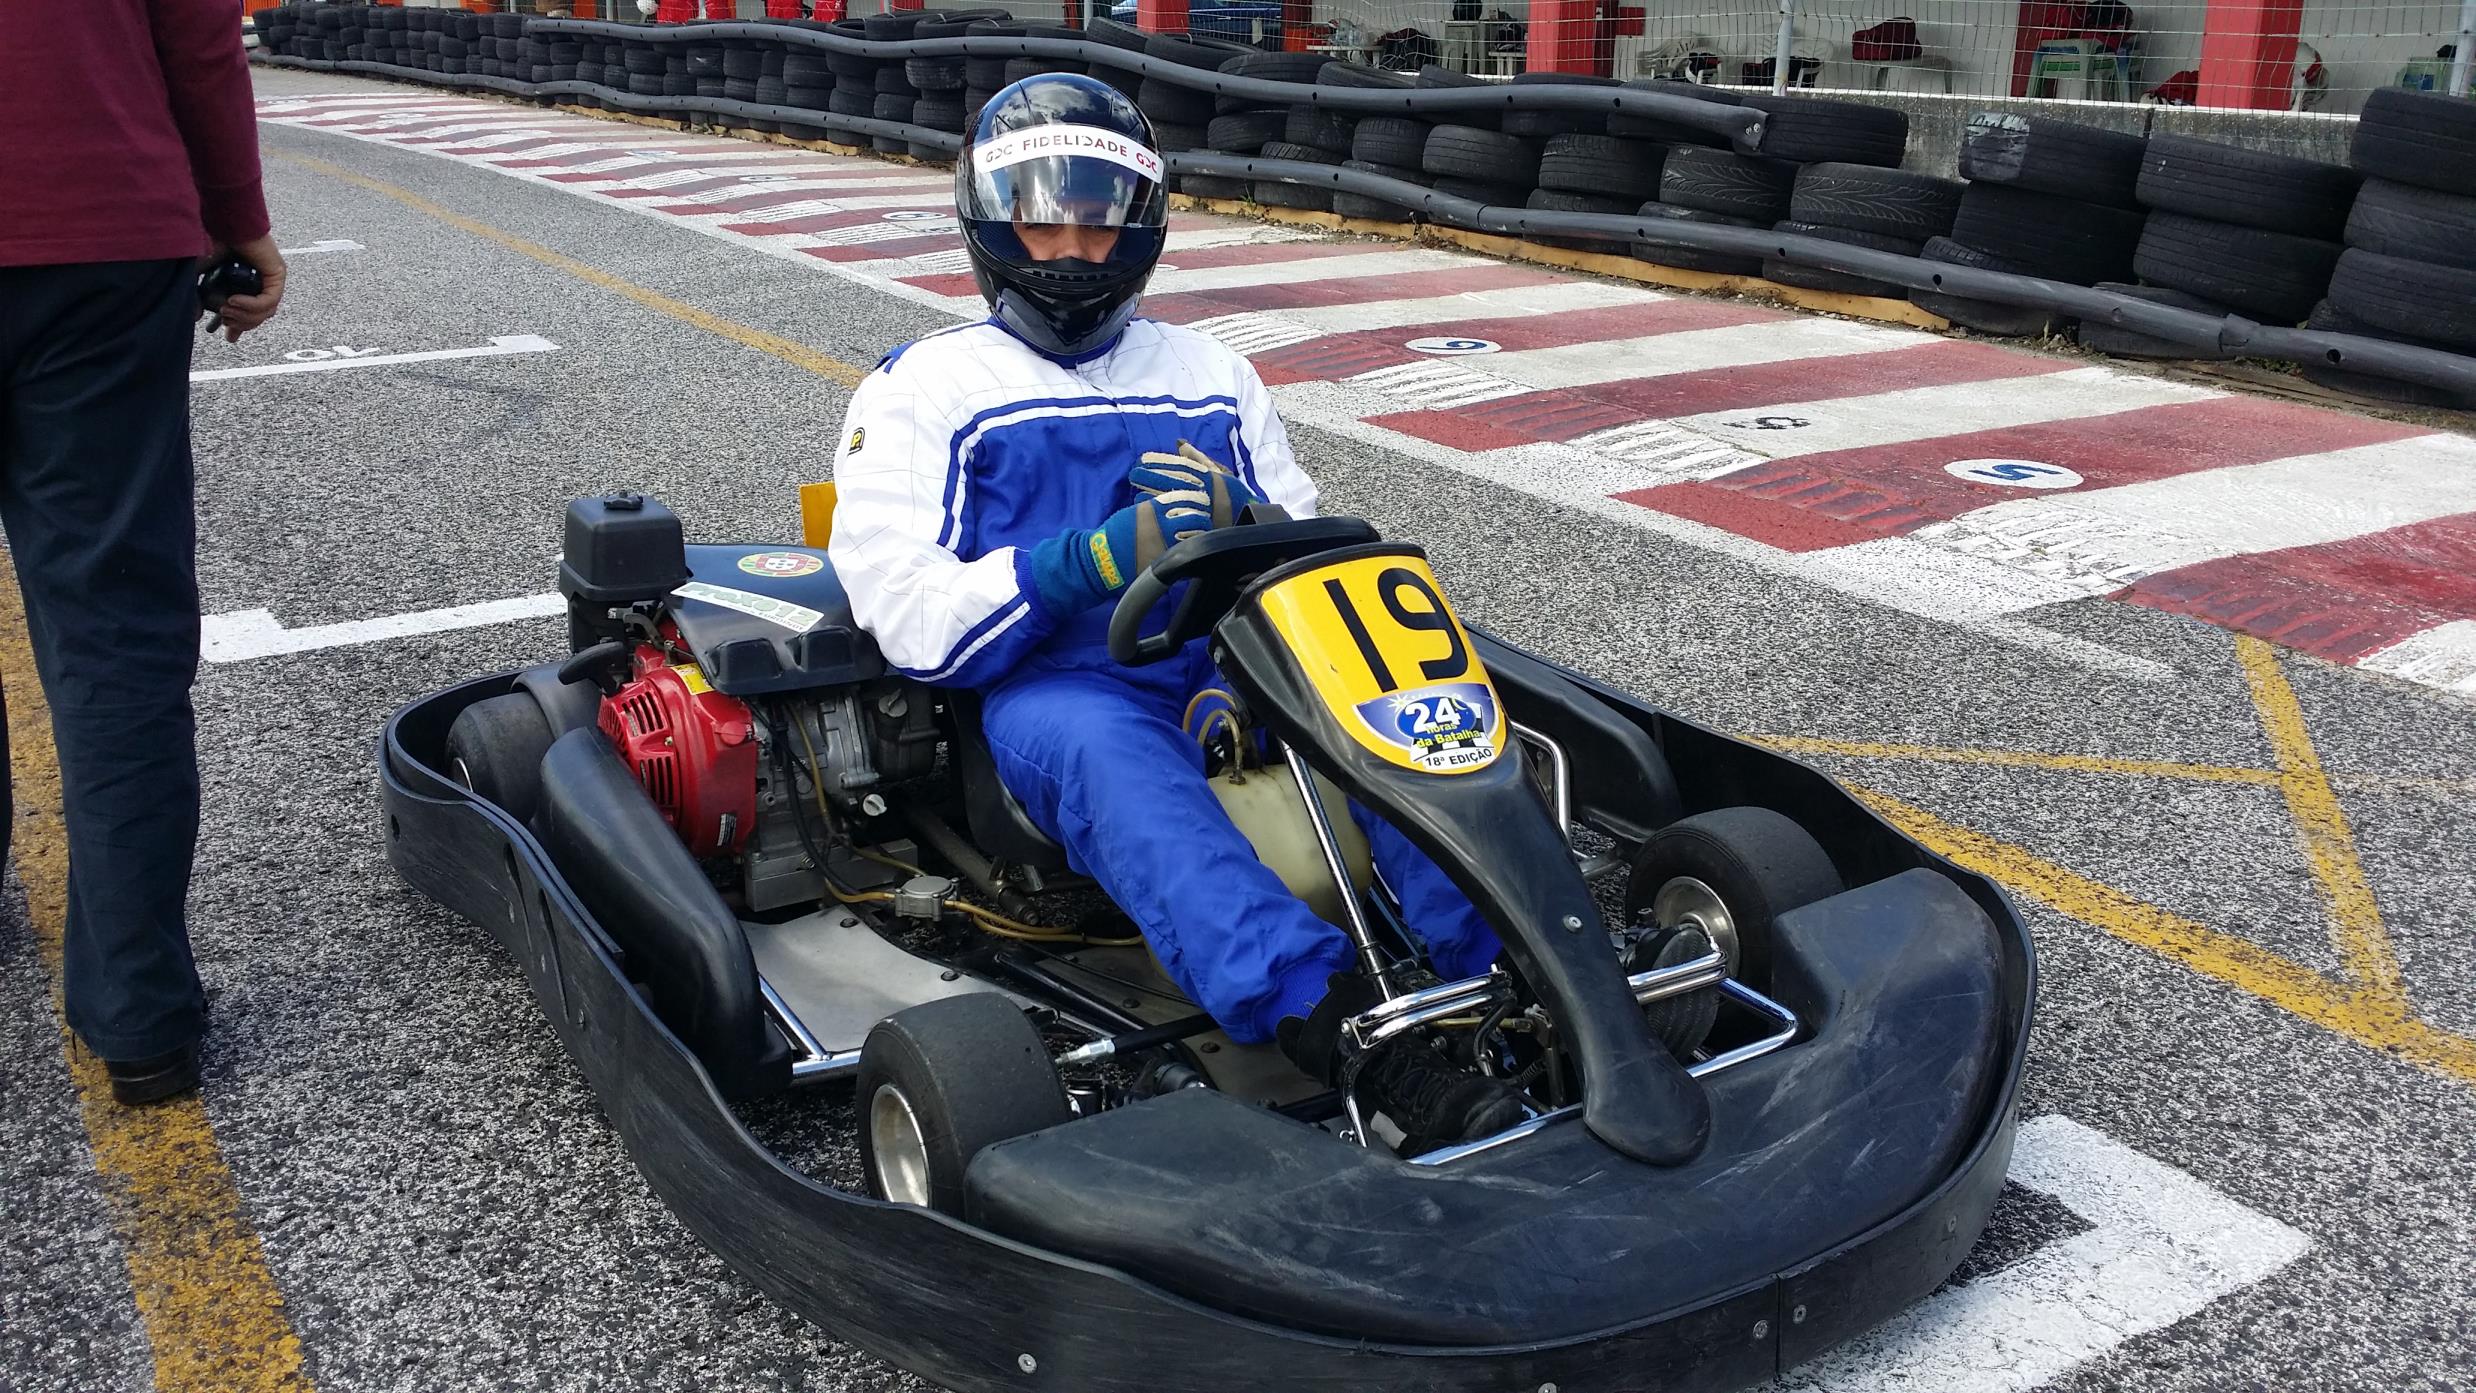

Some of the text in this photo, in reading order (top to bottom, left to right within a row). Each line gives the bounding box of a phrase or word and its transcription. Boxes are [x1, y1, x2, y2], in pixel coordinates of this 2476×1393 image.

[1023, 135, 1128, 157] FIDELIDADE
[1323, 567, 1469, 693] 19
[1405, 697, 1461, 733] 24
[1416, 729, 1480, 748] da Batalha
[1448, 748, 1492, 764] EDIÇÃO
